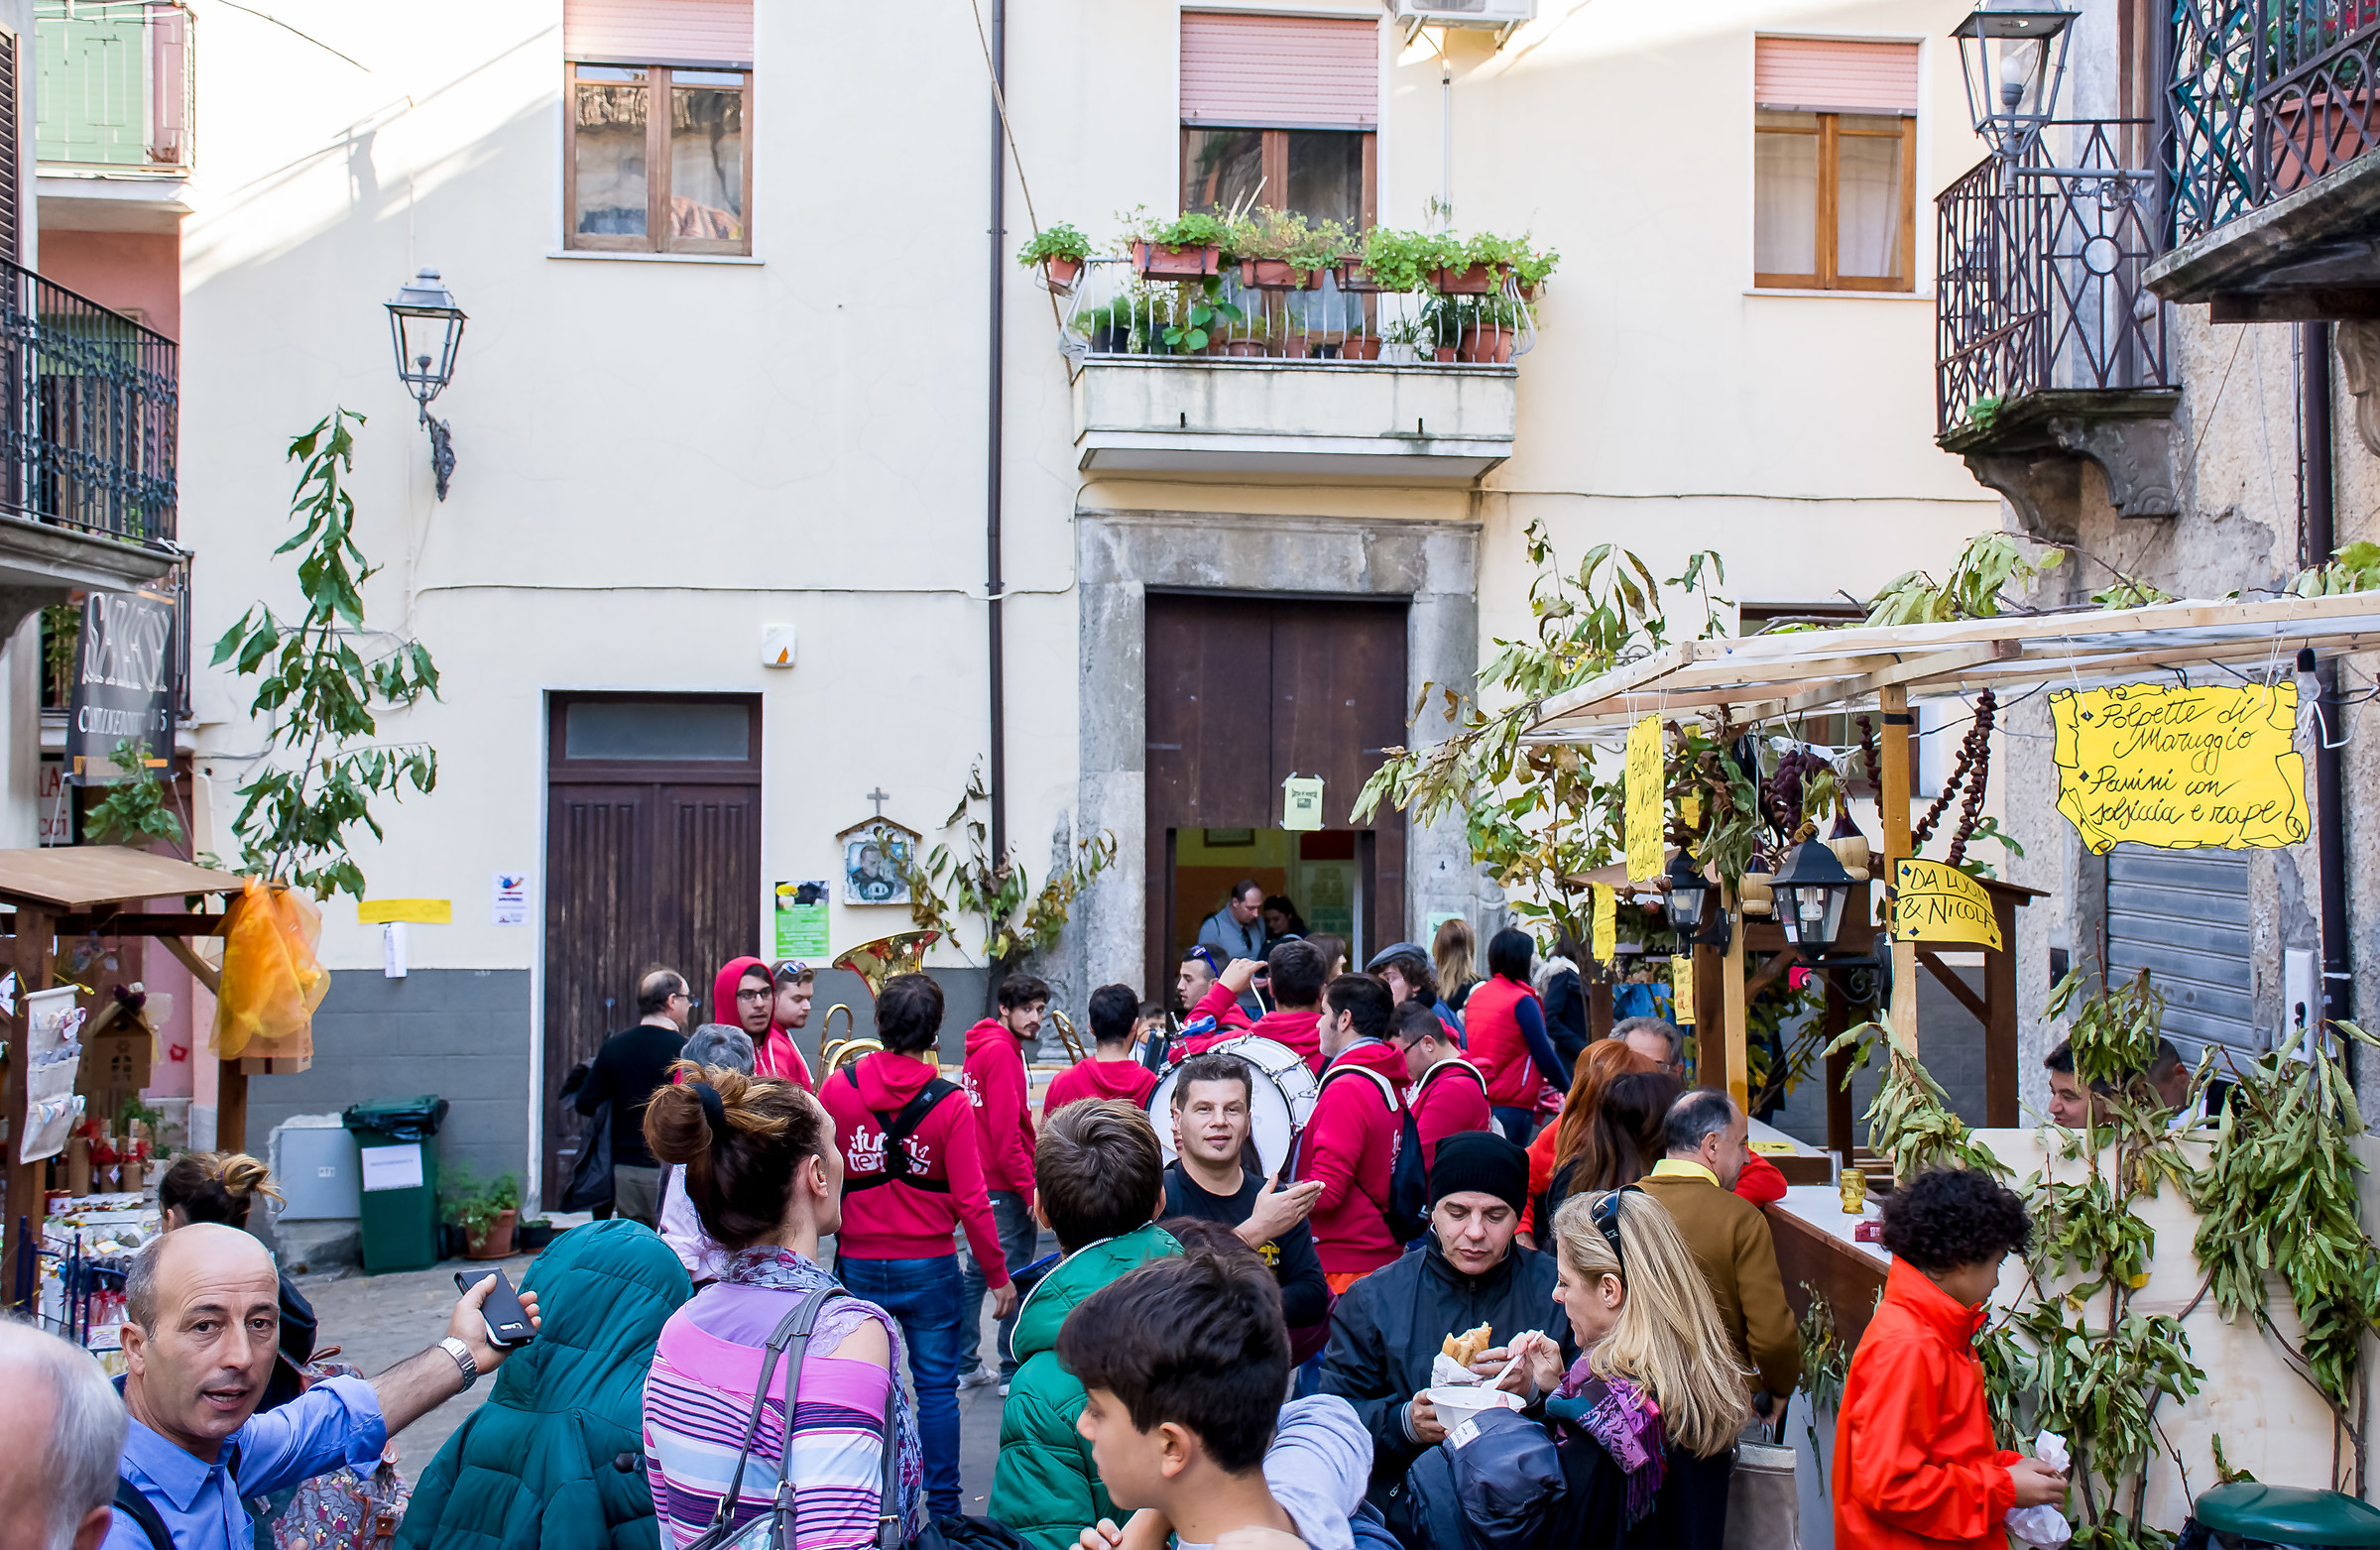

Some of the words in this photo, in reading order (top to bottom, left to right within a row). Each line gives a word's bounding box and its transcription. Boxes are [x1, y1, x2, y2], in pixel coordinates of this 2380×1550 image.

[2095, 698, 2215, 729] Polpette
[2218, 697, 2265, 724] di
[2114, 727, 2258, 775] Maruggio
[2090, 766, 2178, 793] Panini
[2186, 780, 2241, 796] con
[2192, 804, 2204, 821] e
[2210, 800, 2282, 836] rape
[1911, 868, 1940, 892] DA
[1903, 897, 1924, 919] &
[1929, 896, 1995, 932] NICOLA
